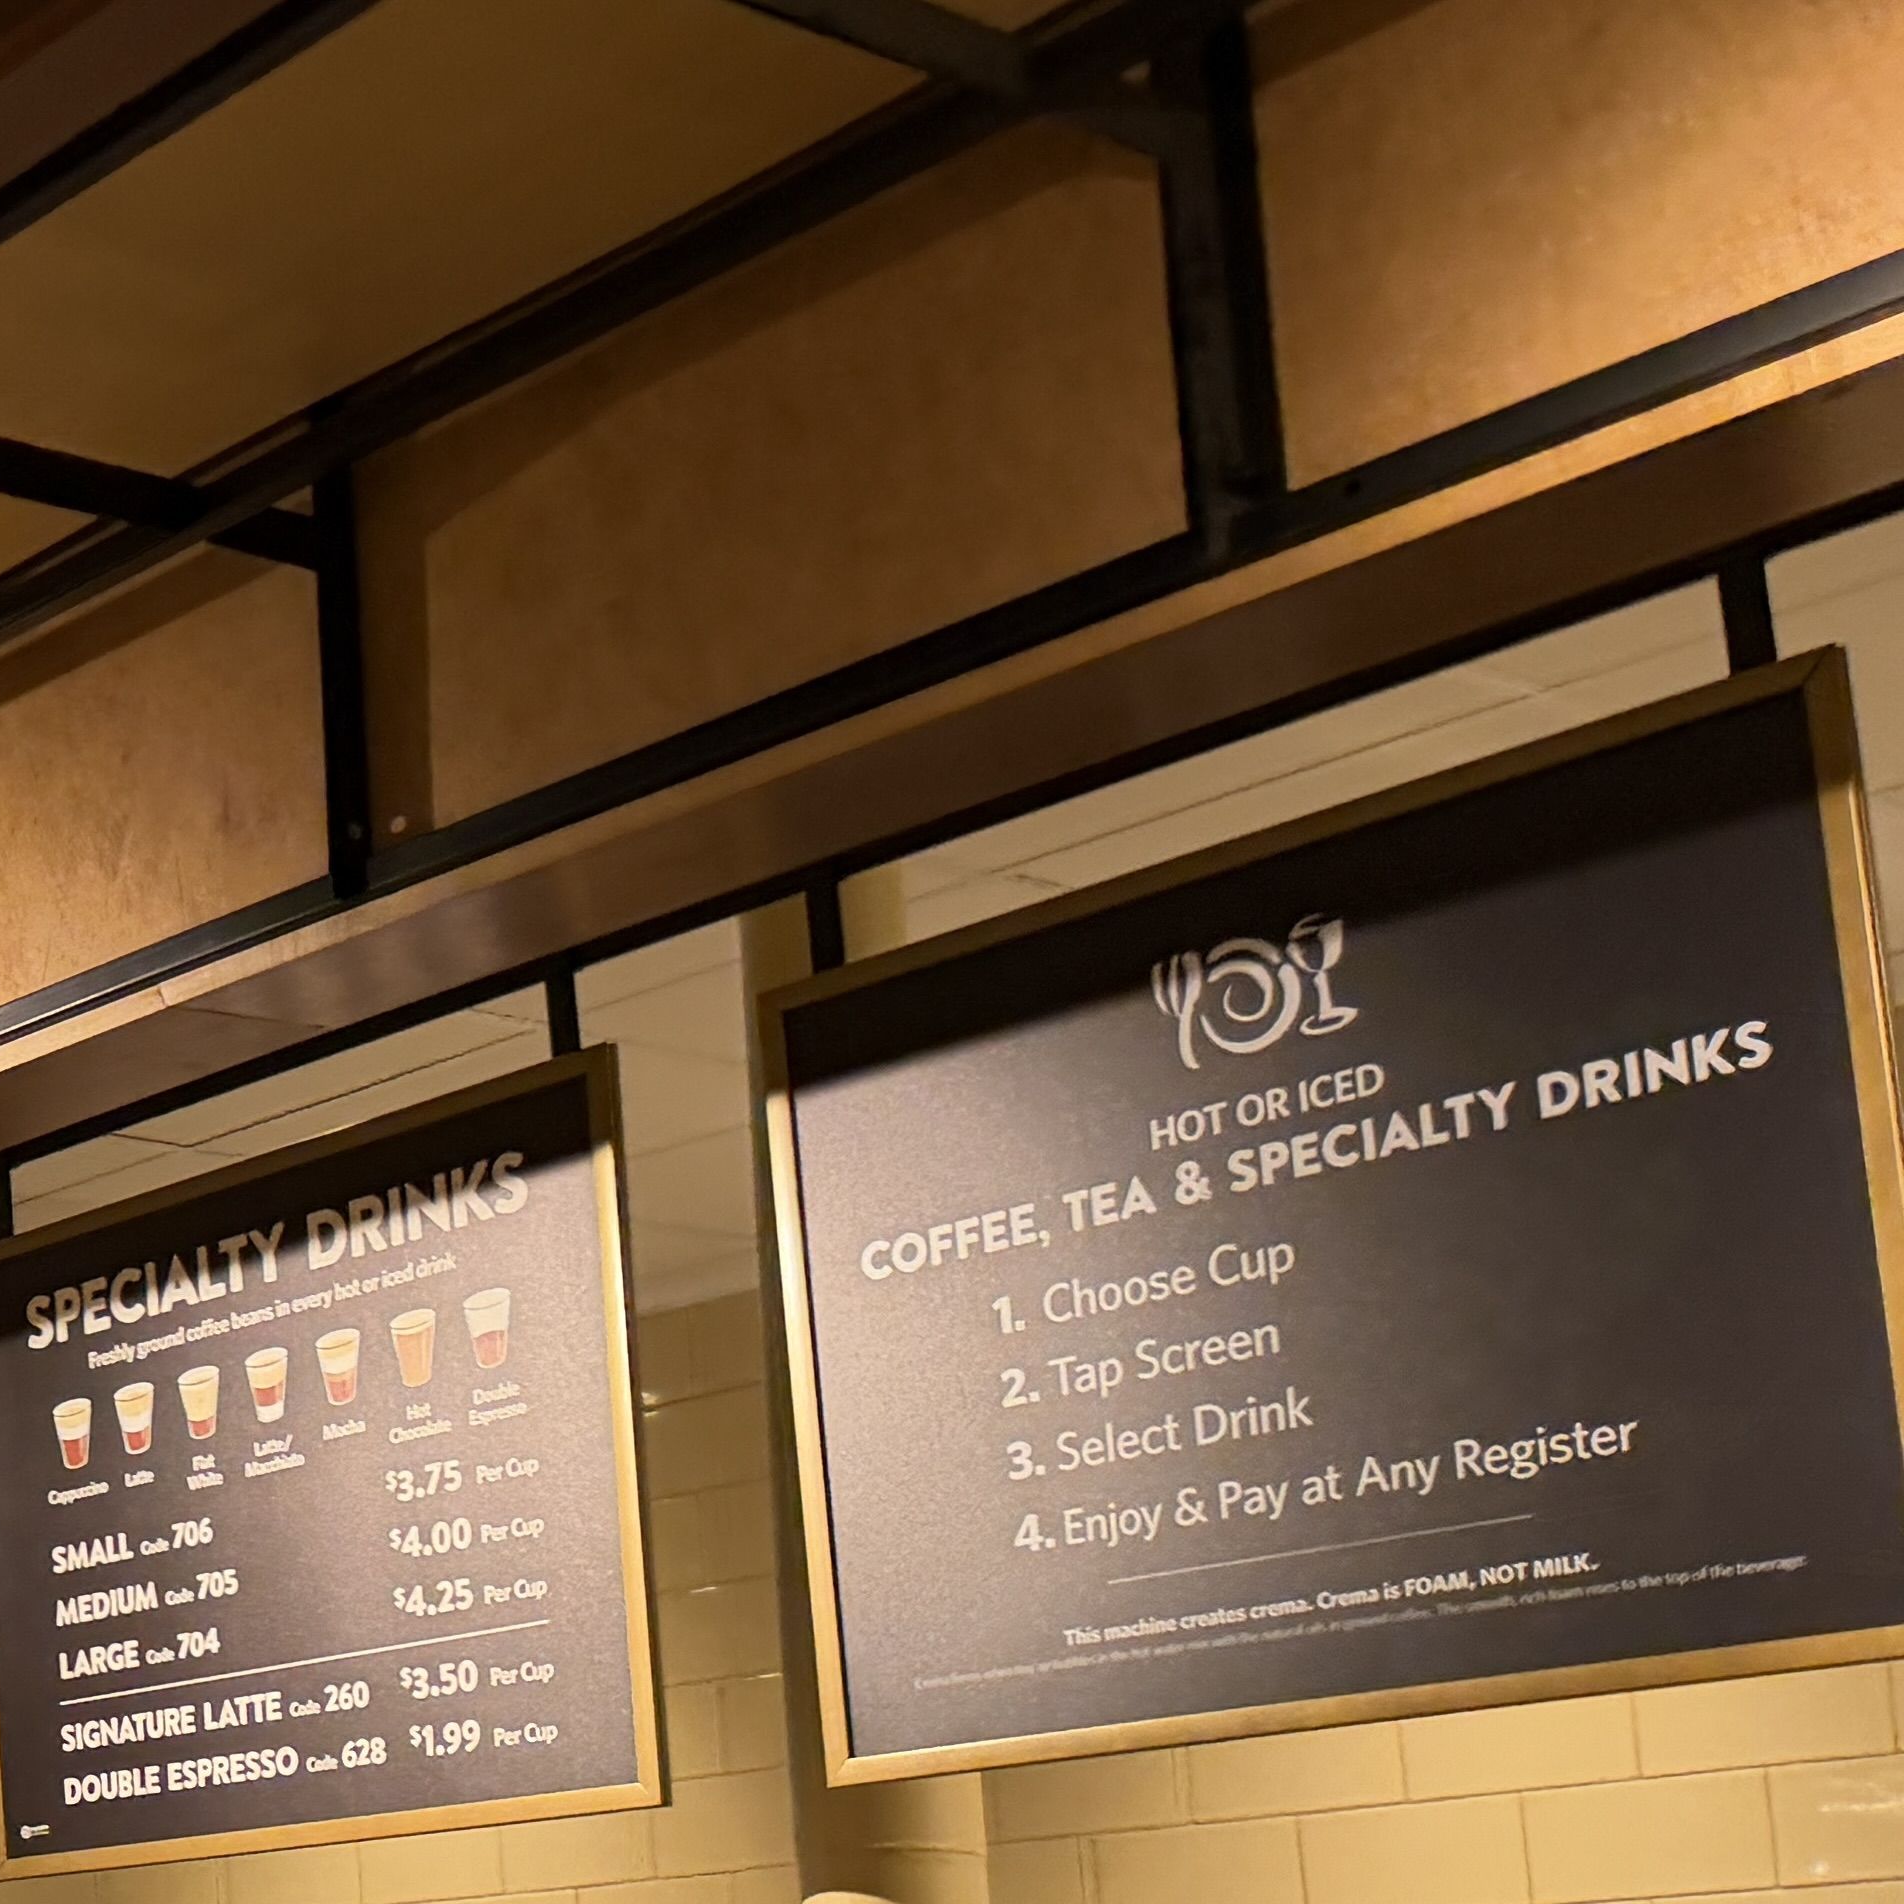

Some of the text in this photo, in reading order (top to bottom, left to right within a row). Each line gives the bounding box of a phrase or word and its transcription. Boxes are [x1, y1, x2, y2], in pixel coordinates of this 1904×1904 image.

[861, 1020, 1774, 1281] COFFEE, TEA & SPECIALTY DRINKS
[1149, 1064, 1385, 1151] HOT OR ICED
[27, 1152, 530, 1349] SPECIALTY DRINKS
[992, 1243, 1295, 1334] 1. Choose Cup
[88, 1252, 456, 1370] Freshly ground coffee beans in every hot or iced drink
[1000, 1324, 1281, 1408] 2. Tap Screen
[1006, 1386, 1314, 1481] 3. Select Drink
[52, 1457, 539, 1574] SMALL Code 706 $3.75 Per Cup
[1013, 1419, 1639, 1551] 4. Enjoy & Pay at Any Register
[56, 1517, 544, 1627] MEDIUM Code 705 $4.00 Per Cup
[1063, 1551, 1601, 1646] This machine creates crema. Crema is FOAM, NOT MILK.
[59, 1578, 548, 1680] LARGE Code 704 $4.25 Per Cup
[60, 1660, 555, 1752] SIGNATURE LATTE Code 260 $3.50 Per Cup
[63, 1719, 558, 1806] DOUBLE ESPRESSO Code 628 $1.99 Per Cup
